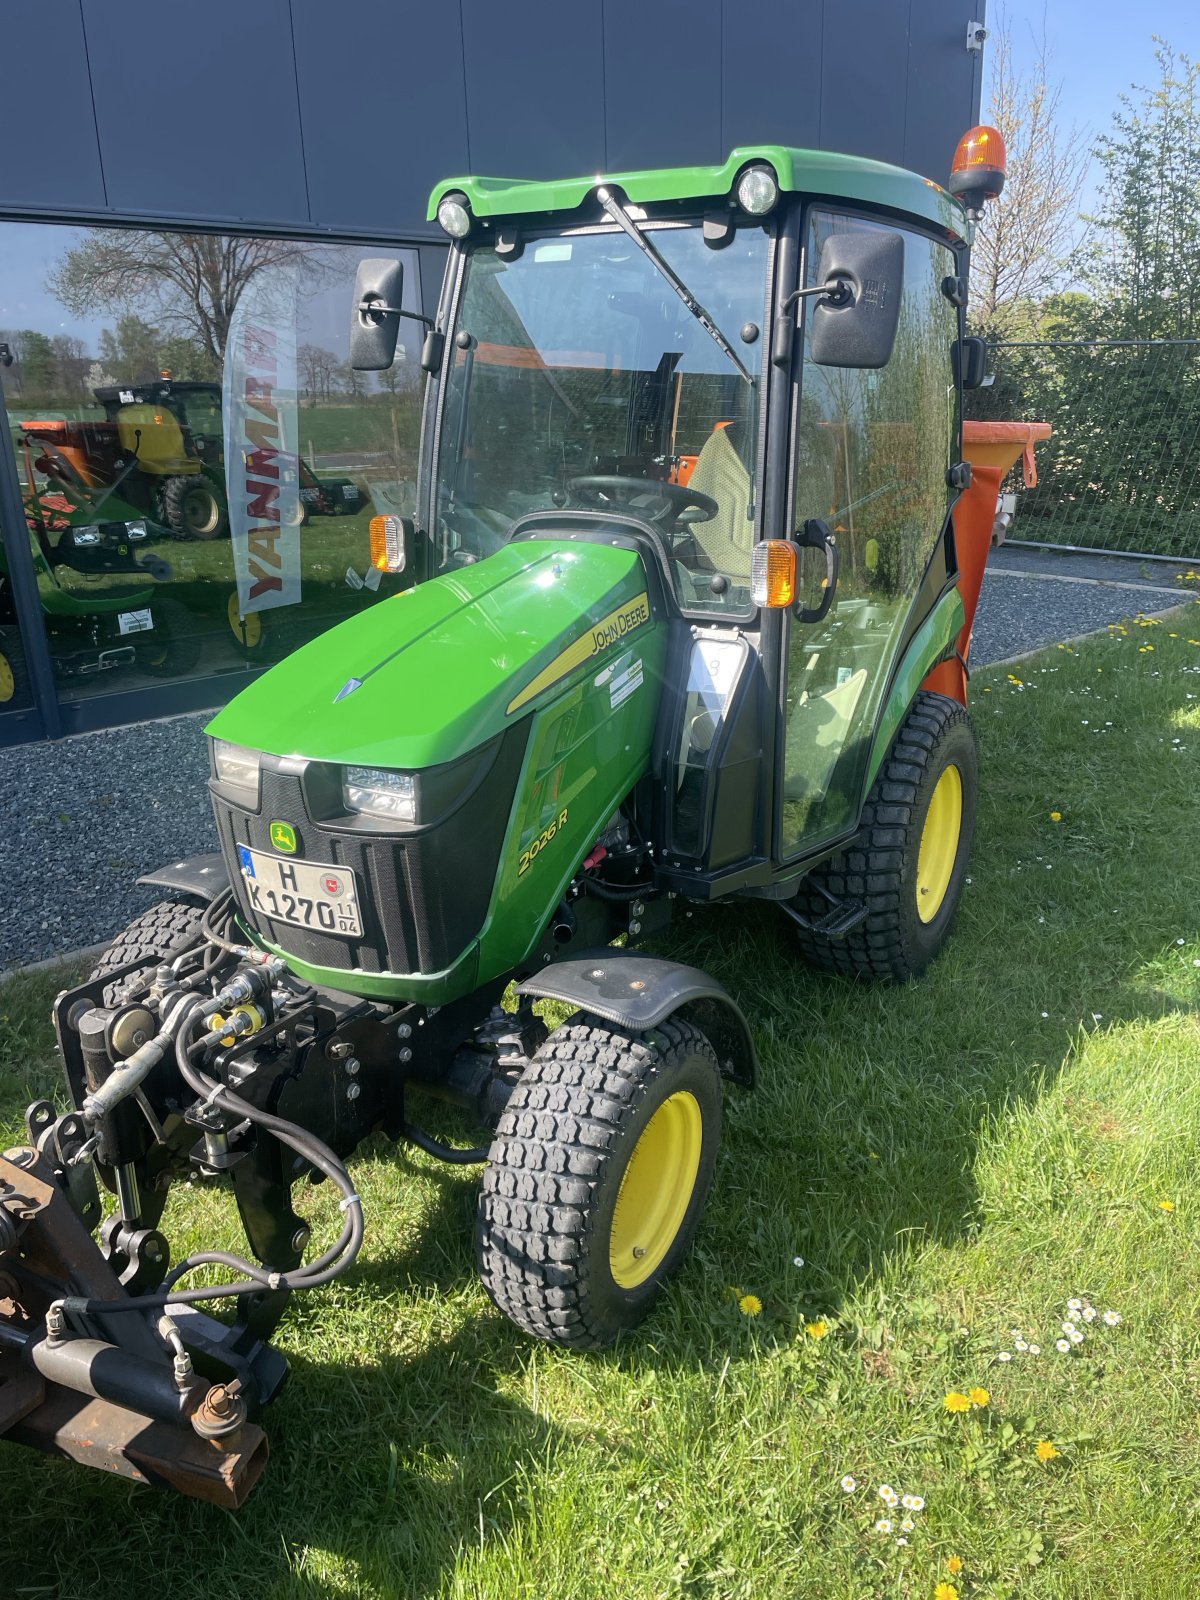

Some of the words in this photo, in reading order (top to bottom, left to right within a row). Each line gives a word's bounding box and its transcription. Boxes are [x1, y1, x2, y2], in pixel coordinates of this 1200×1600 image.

[244, 325, 283, 600] YANMAR
[592, 621, 619, 654] JOHN
[617, 604, 647, 634] DEERE
[277, 861, 299, 892] H
[337, 902, 354, 917] 11
[339, 919, 358, 934] 04
